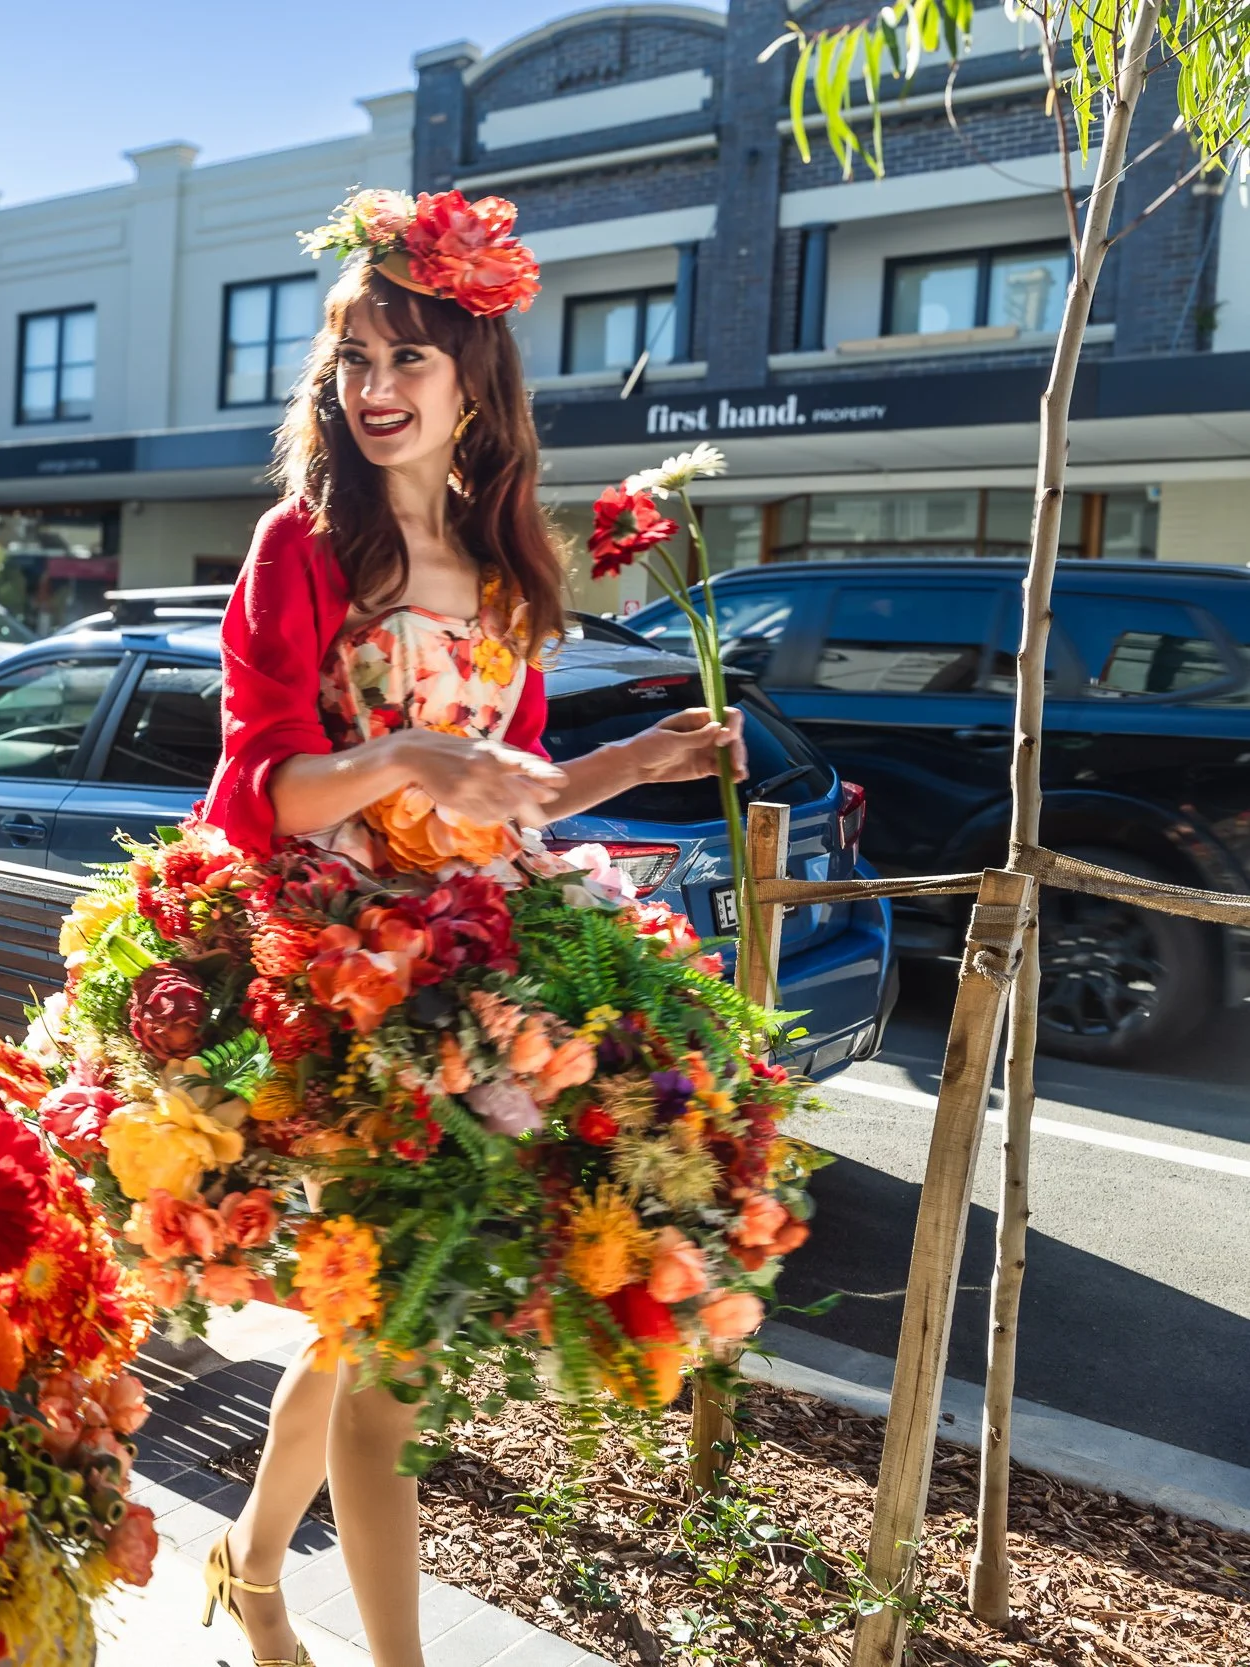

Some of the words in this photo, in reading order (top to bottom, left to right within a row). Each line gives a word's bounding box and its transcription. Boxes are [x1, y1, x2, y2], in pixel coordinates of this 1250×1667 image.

[646, 404, 710, 434] first
[717, 393, 806, 429] hand.
[811, 405, 886, 422] PROPERTY
